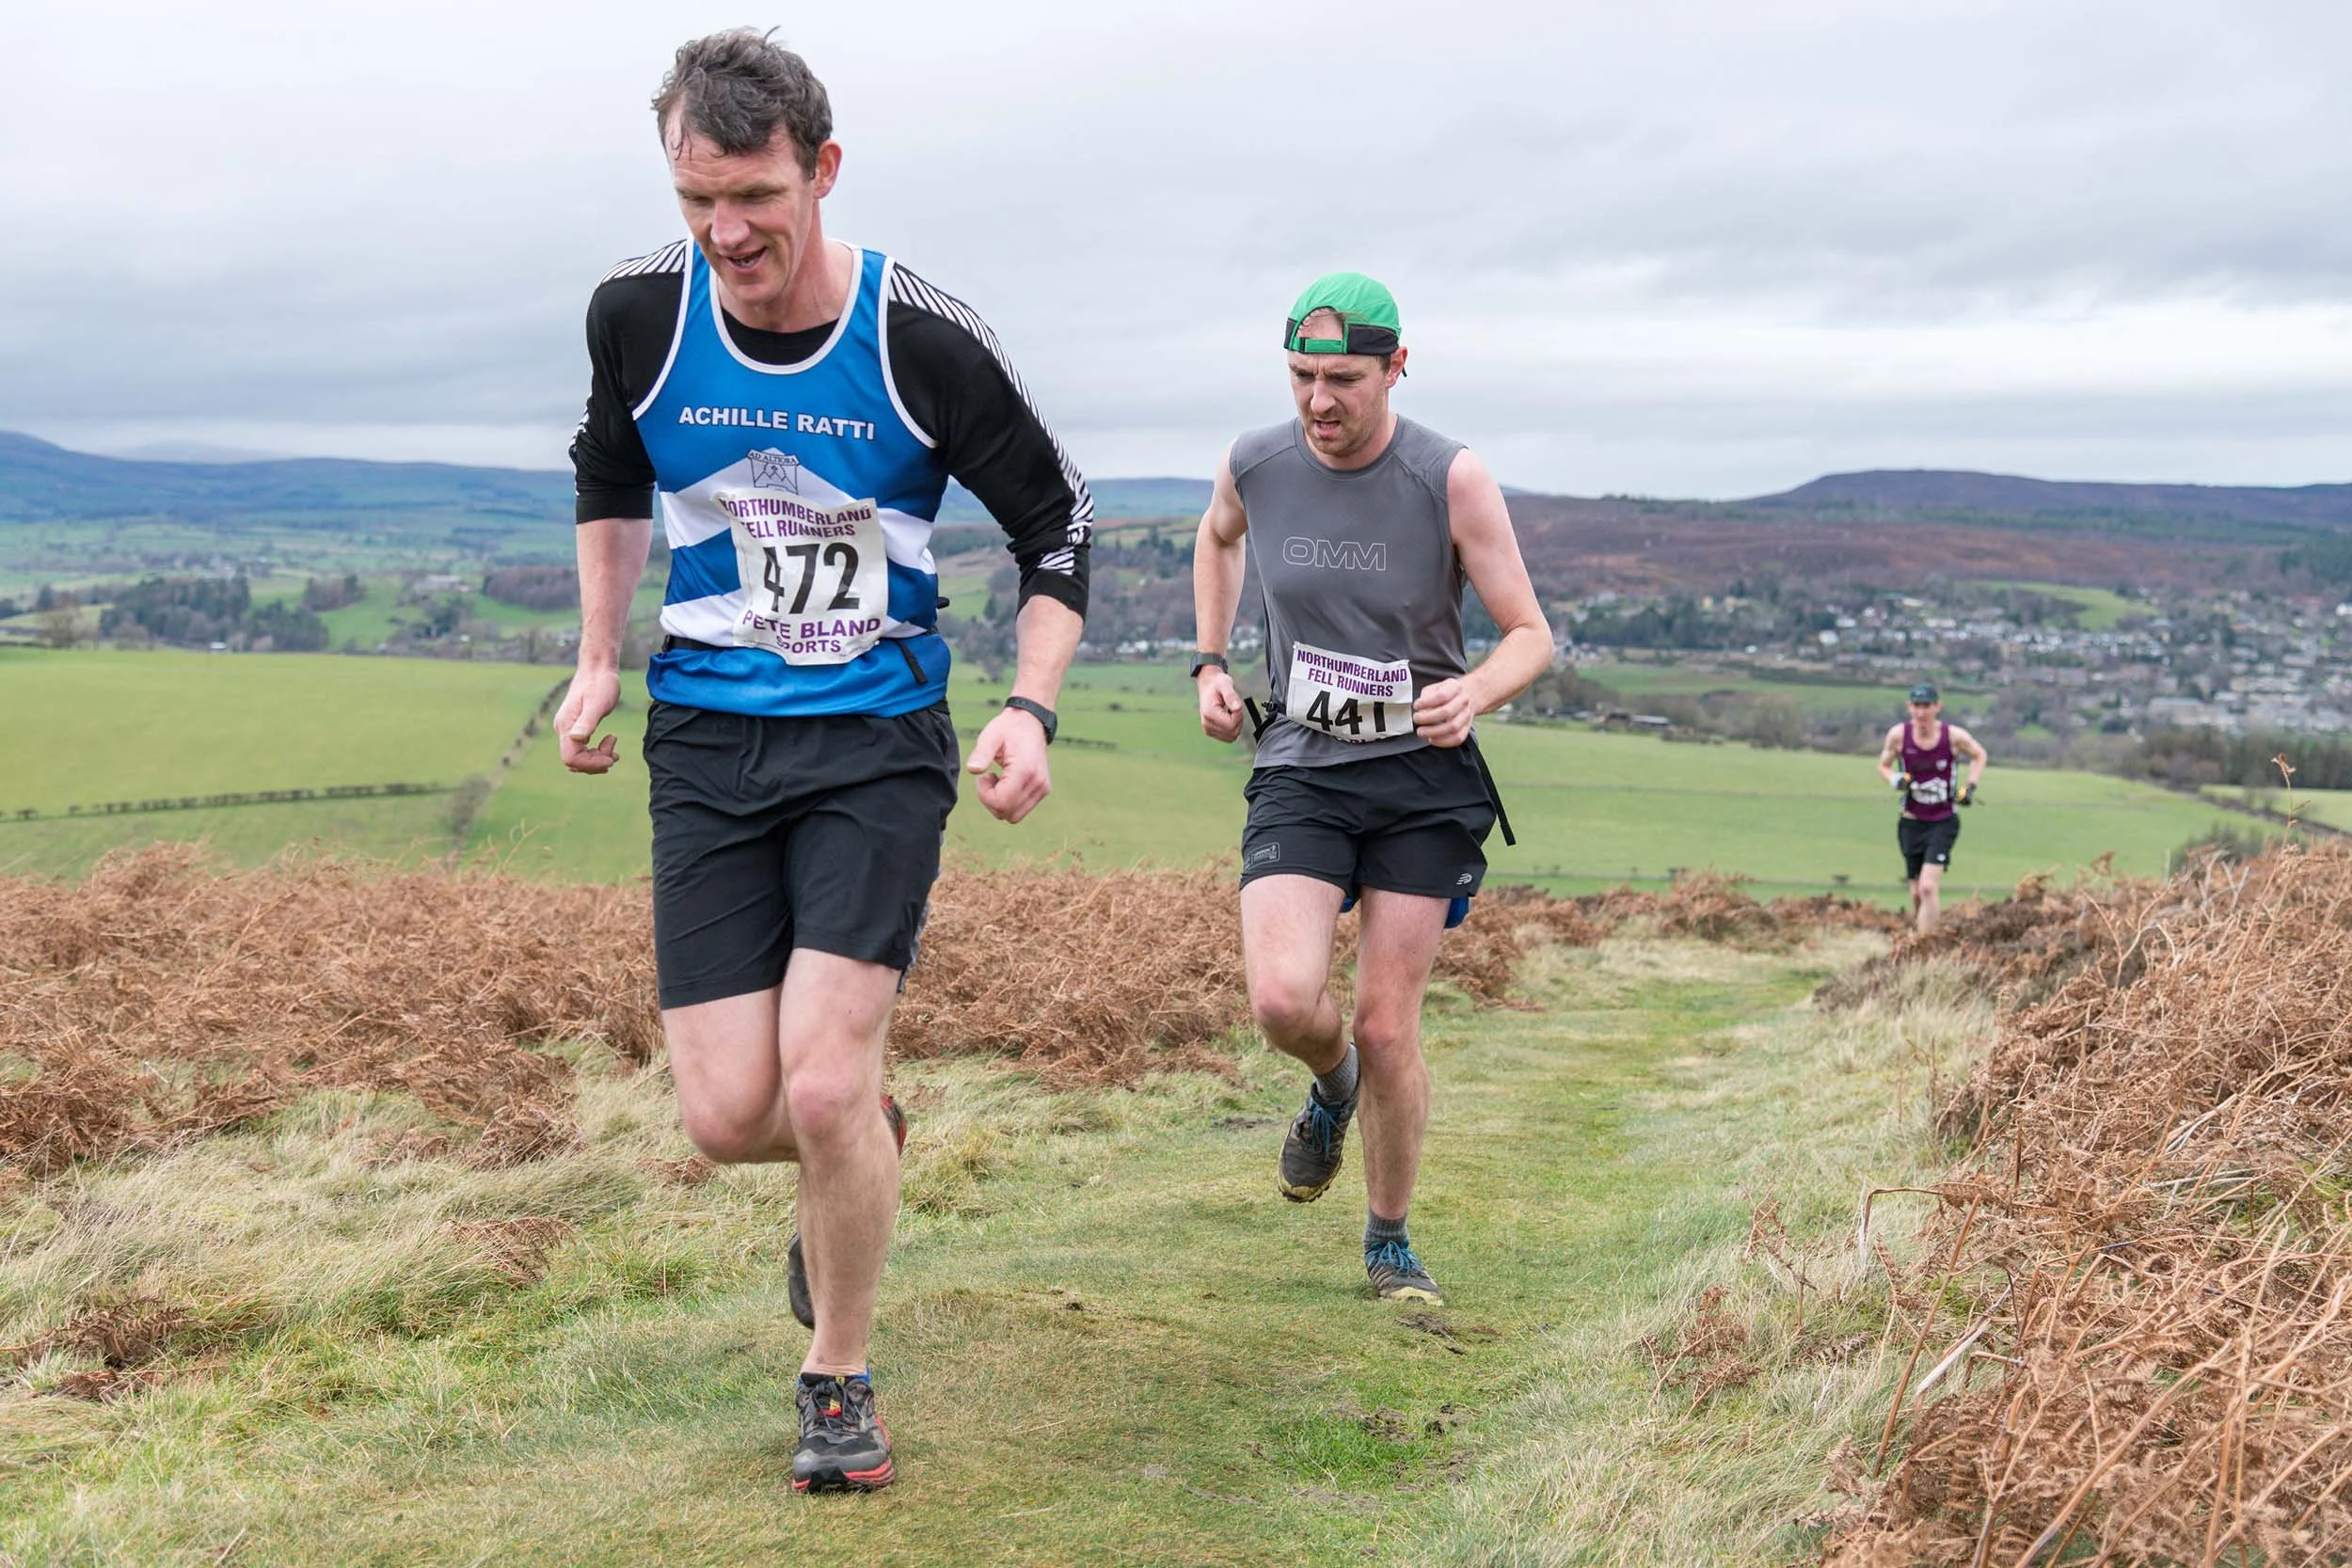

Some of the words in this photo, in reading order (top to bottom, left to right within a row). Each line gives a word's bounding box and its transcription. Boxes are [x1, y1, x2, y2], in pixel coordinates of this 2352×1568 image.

[678, 406, 788, 430] ACHILLE
[797, 414, 875, 440] RATTI
[776, 519, 856, 538] RUNNERS
[1282, 536, 1387, 571] OMM
[763, 542, 861, 615] 472
[742, 609, 791, 641] PETE
[800, 617, 882, 639] BLAND
[776, 635, 841, 654] SPORTS
[1297, 649, 1408, 683] NORTHUMBERLAND
[1308, 668, 1333, 687] FELL
[1336, 675, 1394, 697] RUNNERS
